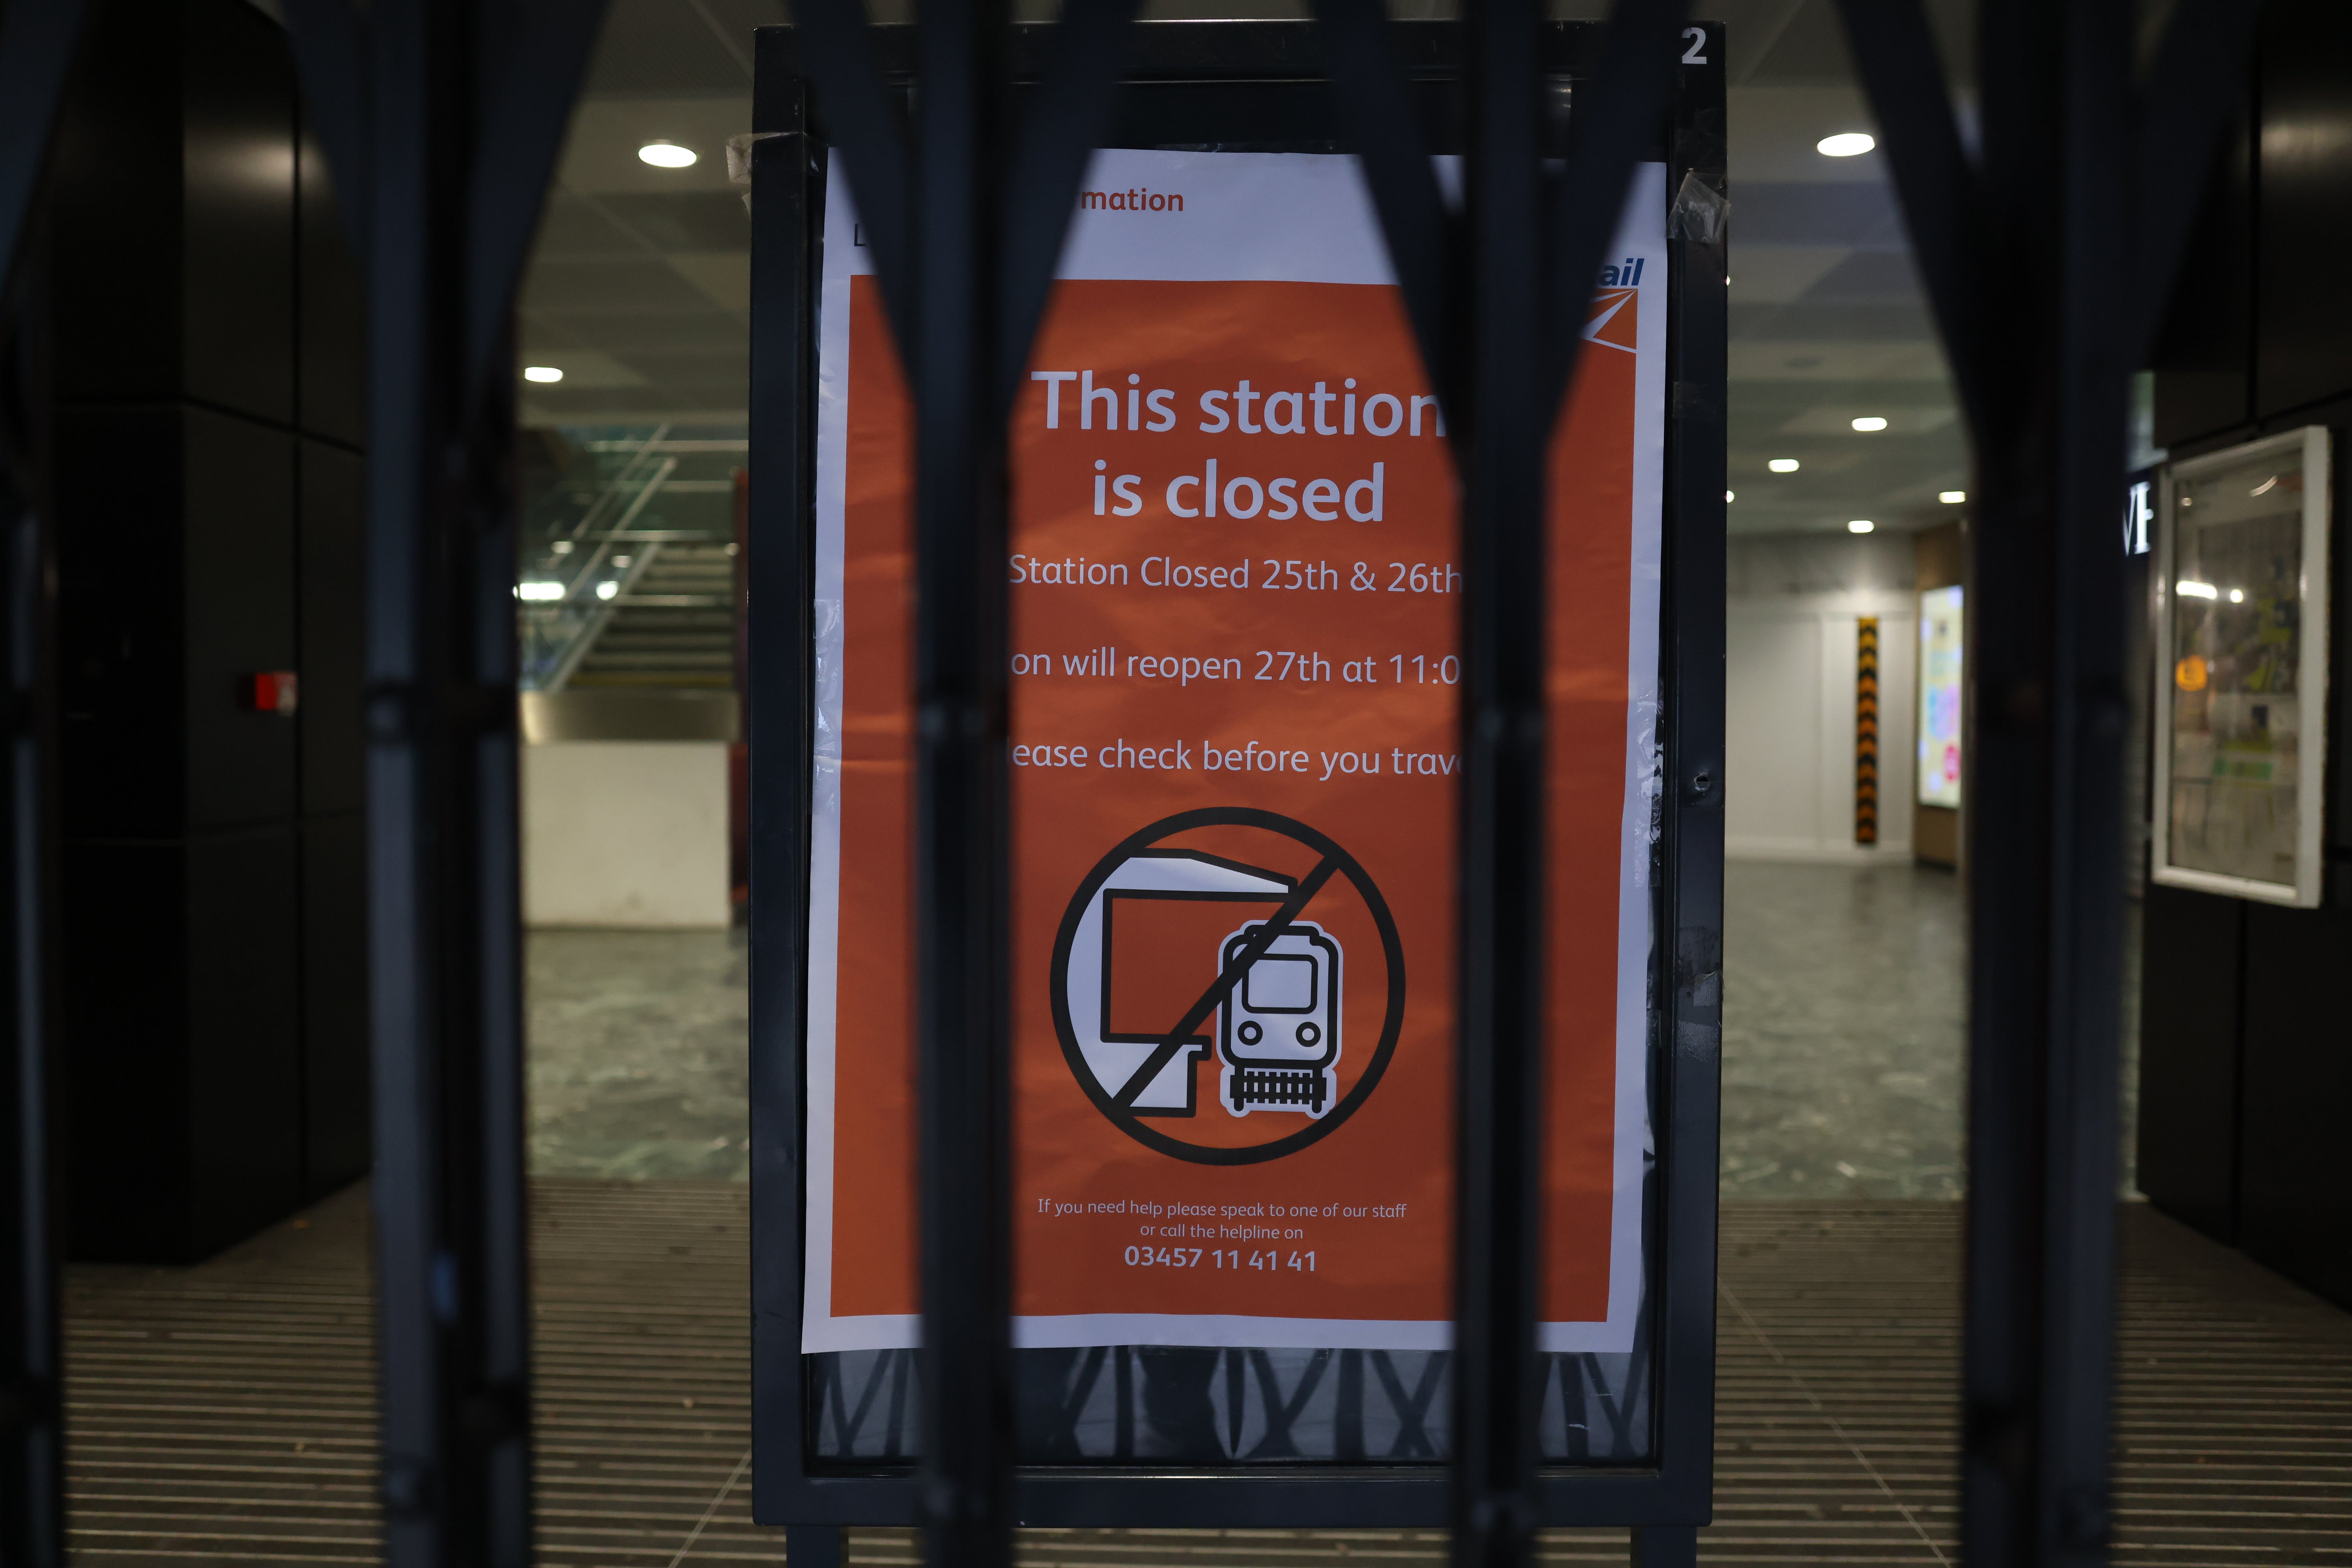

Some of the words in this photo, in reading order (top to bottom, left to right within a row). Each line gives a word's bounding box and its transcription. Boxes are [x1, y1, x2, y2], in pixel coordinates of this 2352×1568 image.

[1681, 27, 1707, 64] 2
[1081, 187, 1183, 211] mation
[1599, 258, 1645, 286] ail
[1031, 370, 1176, 432] This
[1199, 378, 1447, 437] station
[1094, 459, 1142, 517] is
[1166, 458, 1384, 522] closed
[1009, 554, 1128, 585] Station
[1141, 556, 1248, 588] Closed
[1262, 559, 1338, 590] 25th
[1350, 562, 1376, 591] &
[1387, 562, 1463, 593] 26th
[1011, 653, 1050, 675] on
[1062, 647, 1114, 676] will
[1128, 655, 1241, 687] reopen
[1254, 651, 1331, 682] 27th
[1342, 656, 1377, 683] at
[1389, 654, 1461, 685] 11:0
[1012, 744, 1088, 767] ease
[1099, 738, 1192, 769] check
[1204, 740, 1309, 772] before
[1319, 751, 1380, 782] you
[1391, 748, 1462, 775] trav
[1038, 1199, 1051, 1213] If
[1055, 1203, 1082, 1217] you
[1088, 1200, 1125, 1213] need
[1130, 1200, 1163, 1219] help
[1168, 1202, 1216, 1219] please
[1221, 1202, 1264, 1220] speak
[1270, 1204, 1285, 1216] to
[1290, 1206, 1318, 1217] one
[1323, 1203, 1339, 1217] of
[1342, 1206, 1368, 1217] our
[1372, 1204, 1407, 1218] staff
[1140, 1225, 1155, 1236] or
[1160, 1224, 1185, 1237] call
[1190, 1224, 1215, 1238] the
[1220, 1225, 1280, 1242] helpline
[1285, 1227, 1303, 1239] on
[1125, 1246, 1203, 1267] 03457
[1212, 1250, 1238, 1269] 11
[1249, 1251, 1276, 1270] 41
[1287, 1251, 1315, 1271] 41
